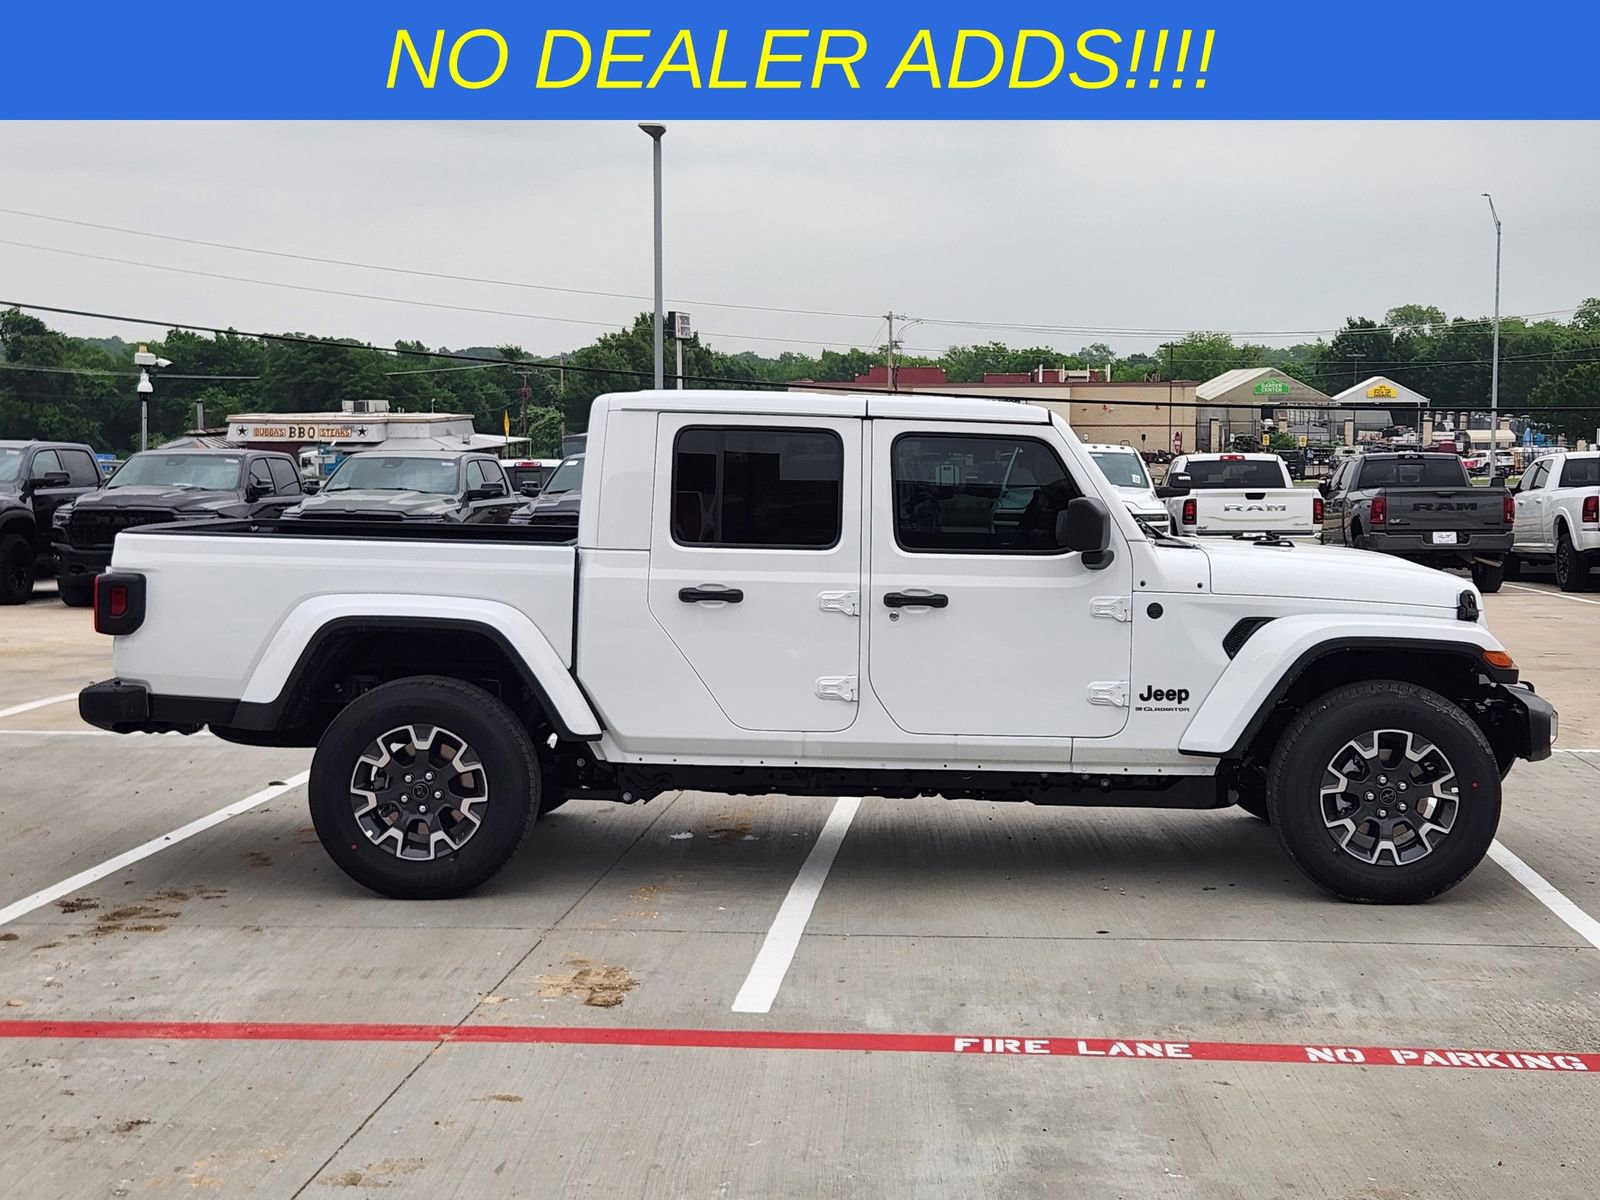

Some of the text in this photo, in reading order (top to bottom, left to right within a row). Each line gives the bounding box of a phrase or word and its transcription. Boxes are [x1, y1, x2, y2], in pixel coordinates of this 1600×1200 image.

[288, 426, 316, 439] BBQ
[320, 428, 352, 437] STEAKS
[1224, 503, 1287, 512] RAM
[1412, 502, 1478, 511] RAM
[1139, 685, 1190, 704] Jeep
[954, 1038, 1192, 1058] FIRE LANE
[1305, 1047, 1588, 1071] NO PARKING
